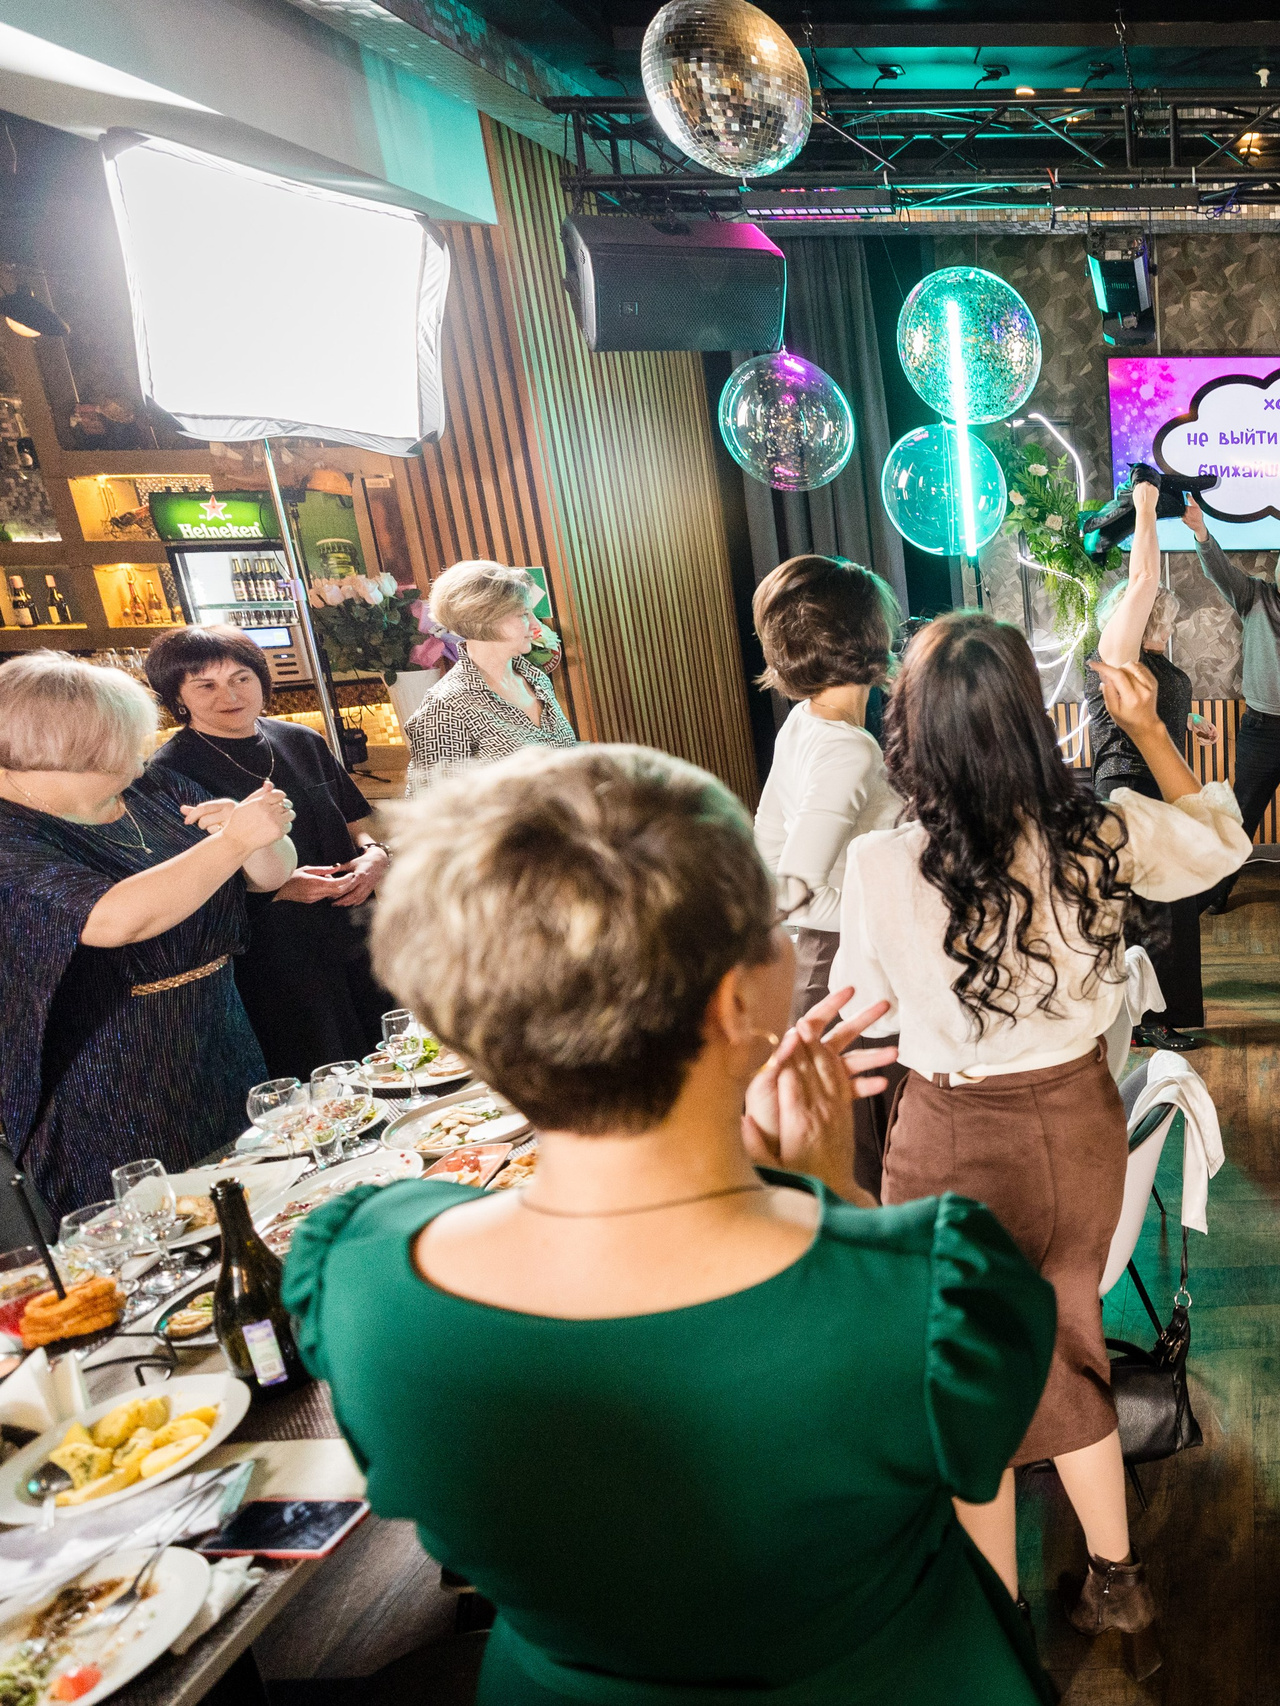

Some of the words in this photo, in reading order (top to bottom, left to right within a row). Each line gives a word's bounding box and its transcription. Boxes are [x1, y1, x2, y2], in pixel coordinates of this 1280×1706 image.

[1187, 431, 1209, 447] не
[1218, 428, 1278, 446] выйти
[177, 522, 263, 539] Heineken
